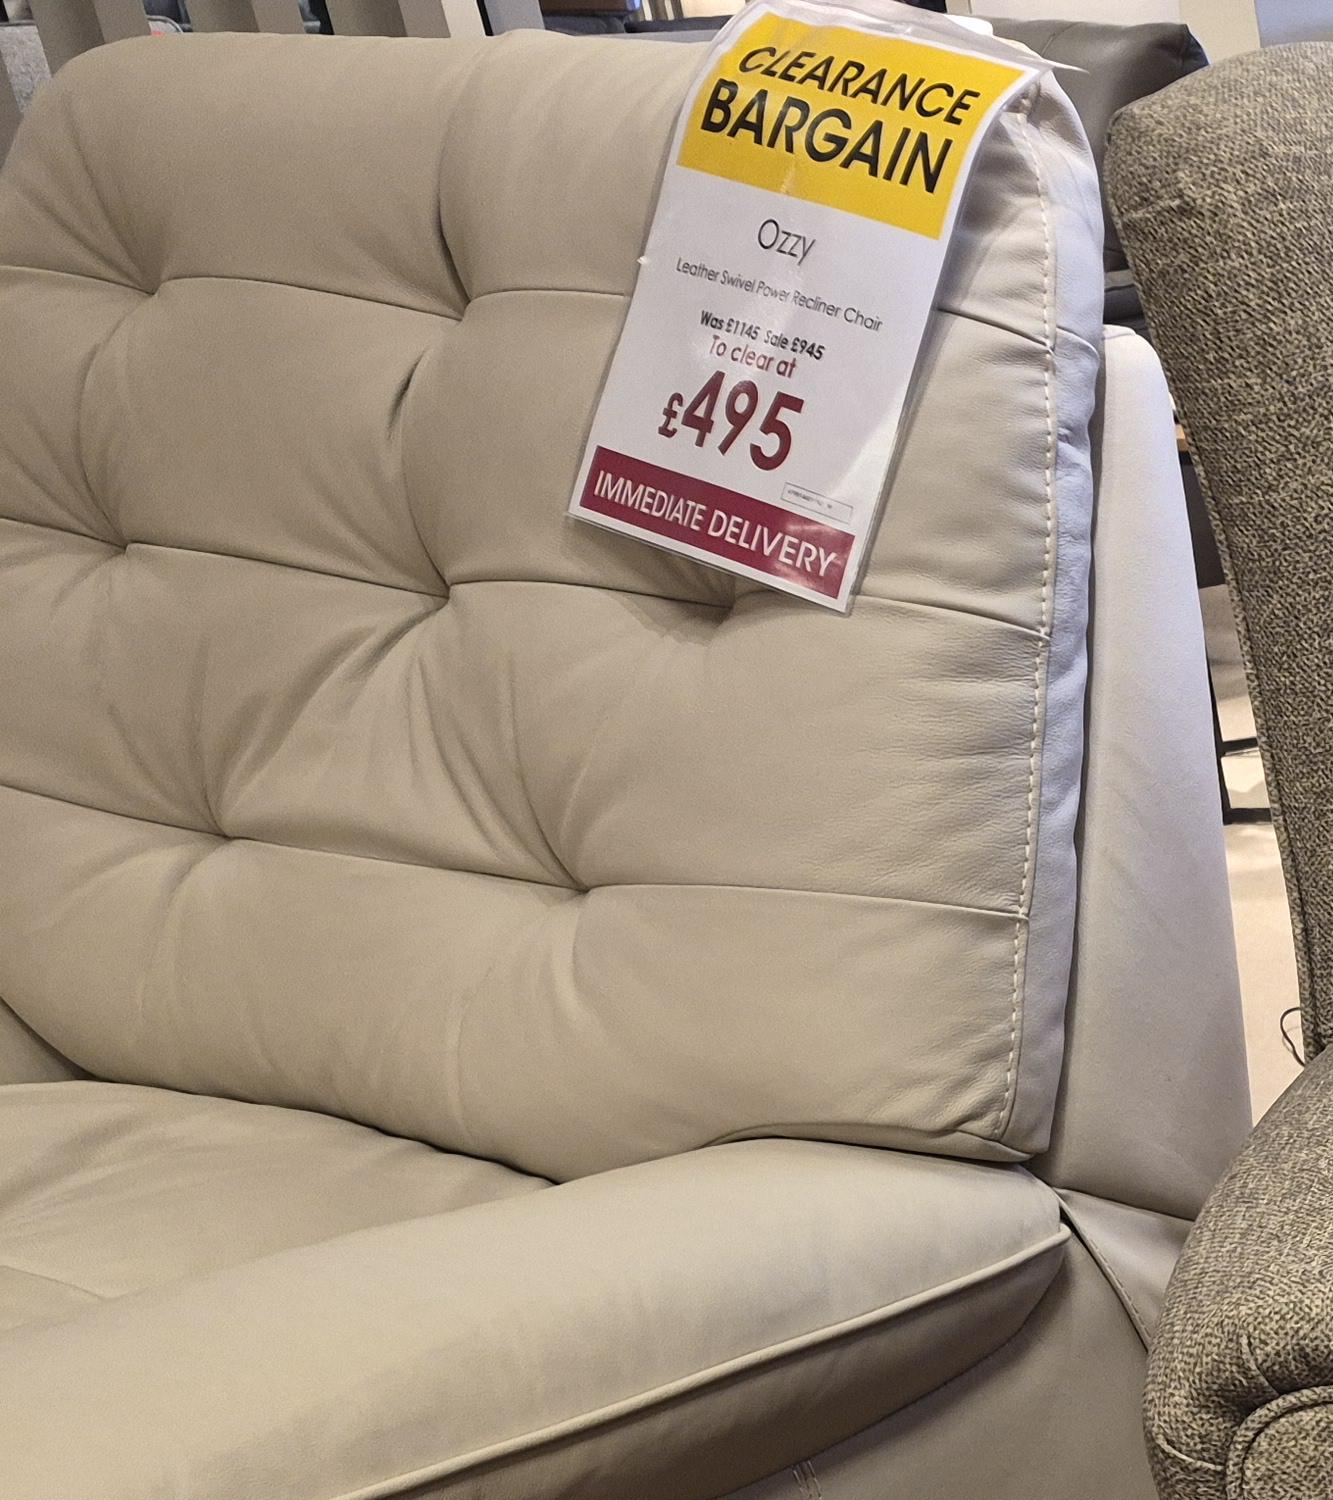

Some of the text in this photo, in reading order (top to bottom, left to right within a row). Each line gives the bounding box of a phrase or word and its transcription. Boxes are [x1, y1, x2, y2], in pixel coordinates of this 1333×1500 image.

[739, 46, 981, 125] CLEARANCE
[700, 77, 953, 194] BARGAIN
[757, 218, 816, 266] Ozzy
[676, 257, 883, 332] Leather Swivel Power Recliner Chair
[700, 309, 826, 360] Was £1145 Sale £945
[709, 334, 796, 379] To clear at
[657, 369, 805, 471] £495
[593, 470, 838, 577] IMMEDIATE DELIVERY
